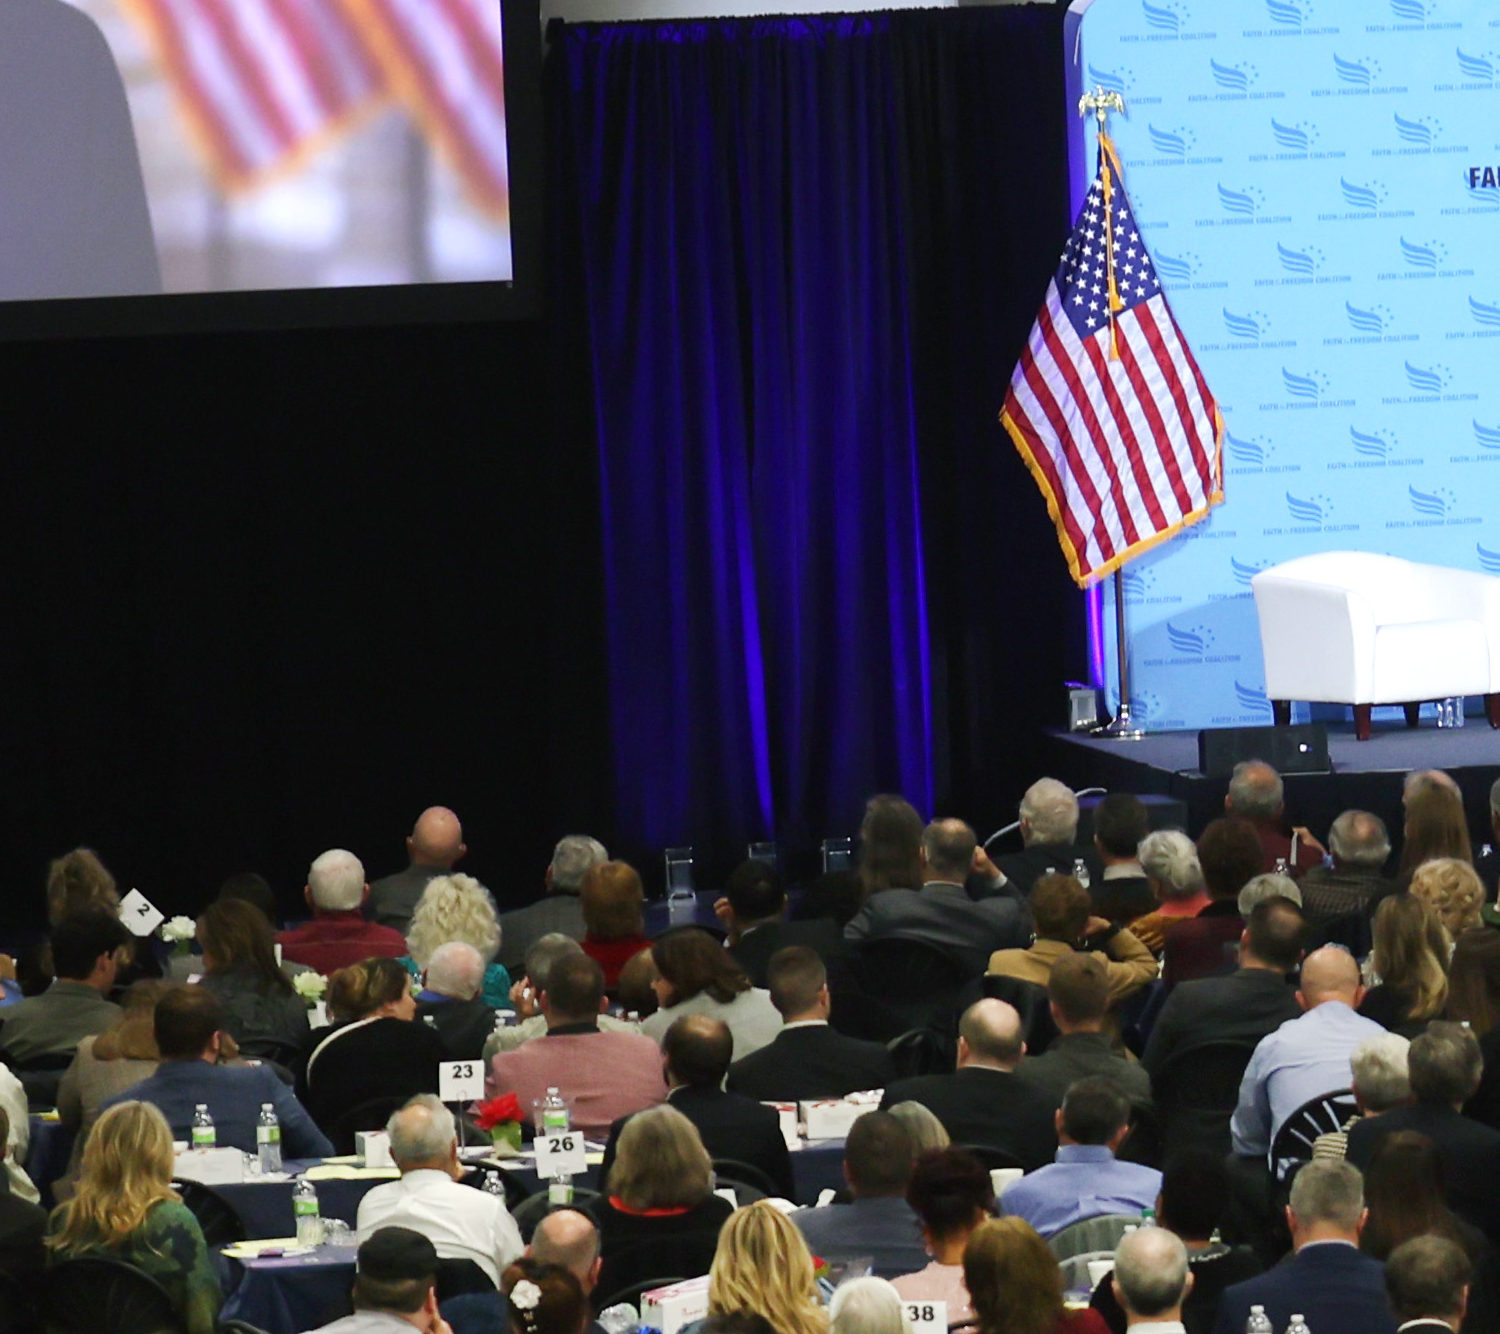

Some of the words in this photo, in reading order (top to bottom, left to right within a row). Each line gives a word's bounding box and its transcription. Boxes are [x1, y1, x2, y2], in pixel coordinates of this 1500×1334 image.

[137, 903, 150, 917] 2
[452, 1064, 473, 1078] 23
[550, 1137, 573, 1153] 26
[909, 1306, 934, 1321] 38
